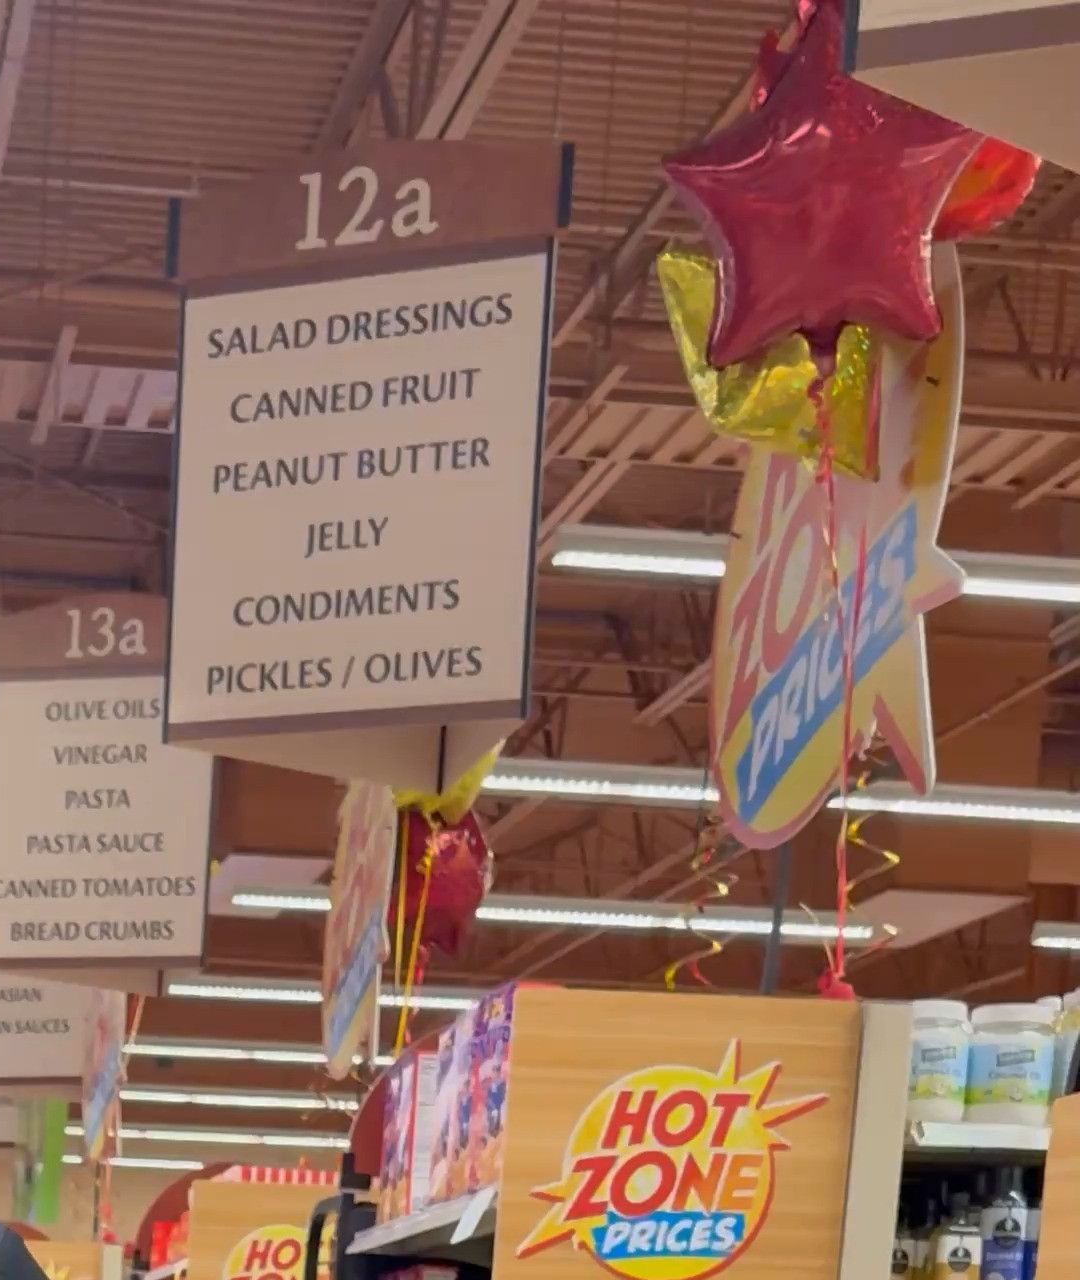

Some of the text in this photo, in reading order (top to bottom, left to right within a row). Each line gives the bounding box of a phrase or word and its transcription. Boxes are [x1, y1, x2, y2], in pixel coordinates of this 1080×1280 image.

[295, 165, 439, 251] 12a
[207, 292, 514, 359] SALAD DRESSINGS
[229, 367, 482, 424] CANNED FRUIT
[213, 437, 491, 494] PEANUT BUTTER
[304, 516, 389, 559] JELLY
[232, 578, 460, 627] CONDIMENTS
[64, 607, 147, 658] 13a
[206, 645, 483, 696] PICKLES / OLIVES
[45, 697, 161, 722] OLIVE OILS
[53, 743, 148, 766] VINEGAR
[64, 788, 131, 810] PASTA
[26, 832, 165, 854] PASTA SAUCE
[82, 876, 196, 897] TOMATOES
[10, 919, 175, 942] BREAD CRUMBS
[601, 1088, 751, 1150] HOT
[563, 1150, 765, 1221] ZONE
[244, 1238, 306, 1272] HO
[602, 1216, 738, 1255] PRICES
